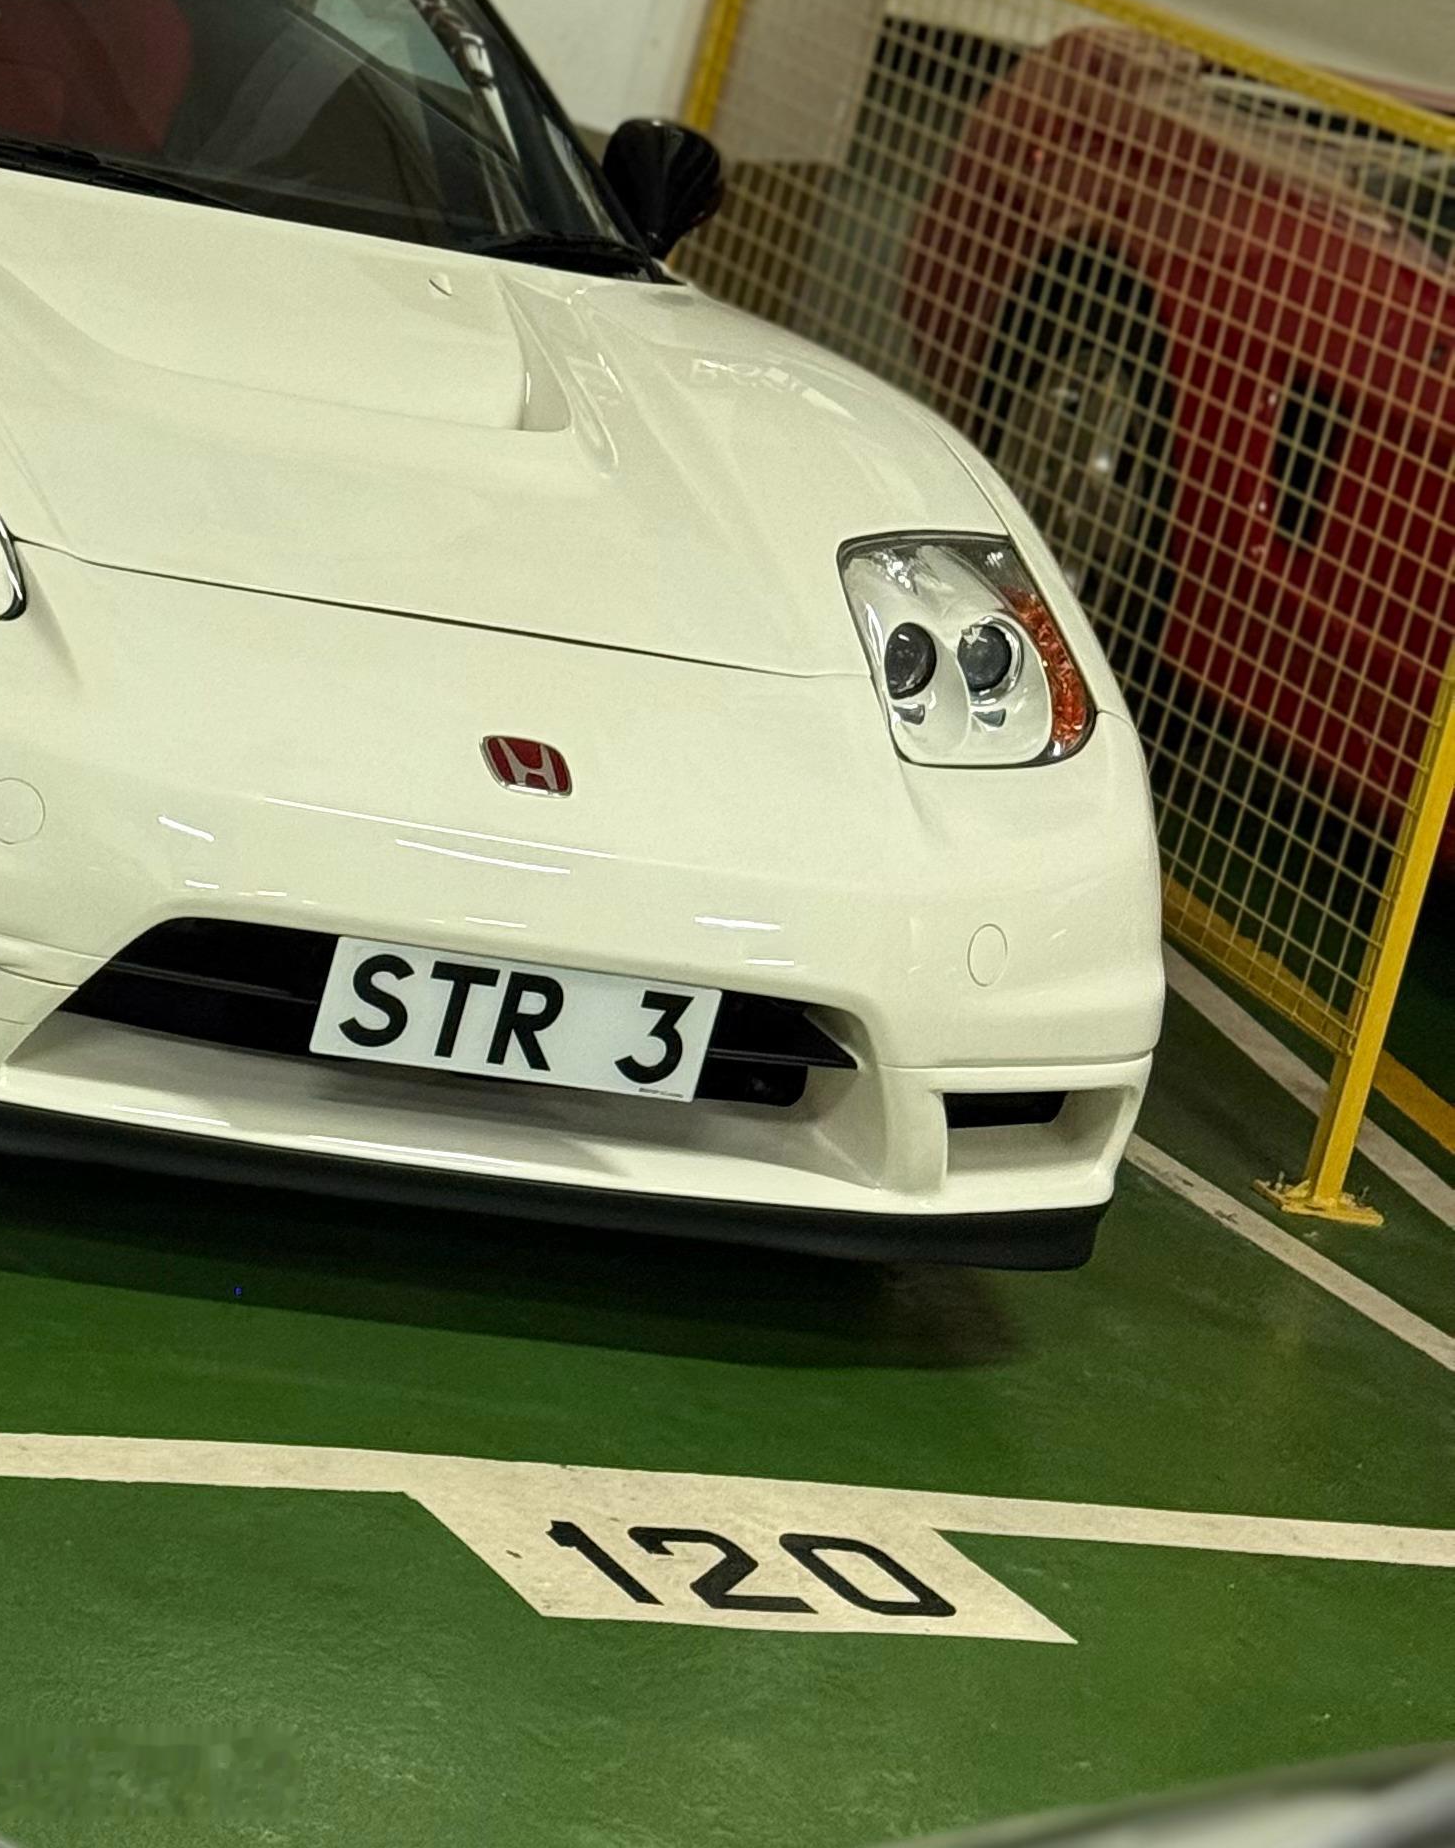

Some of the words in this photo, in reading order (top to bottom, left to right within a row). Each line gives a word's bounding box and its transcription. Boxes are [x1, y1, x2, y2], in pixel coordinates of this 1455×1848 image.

[337, 953, 565, 1072] STR
[613, 989, 695, 1085] 3
[545, 1520, 958, 1618] 120
